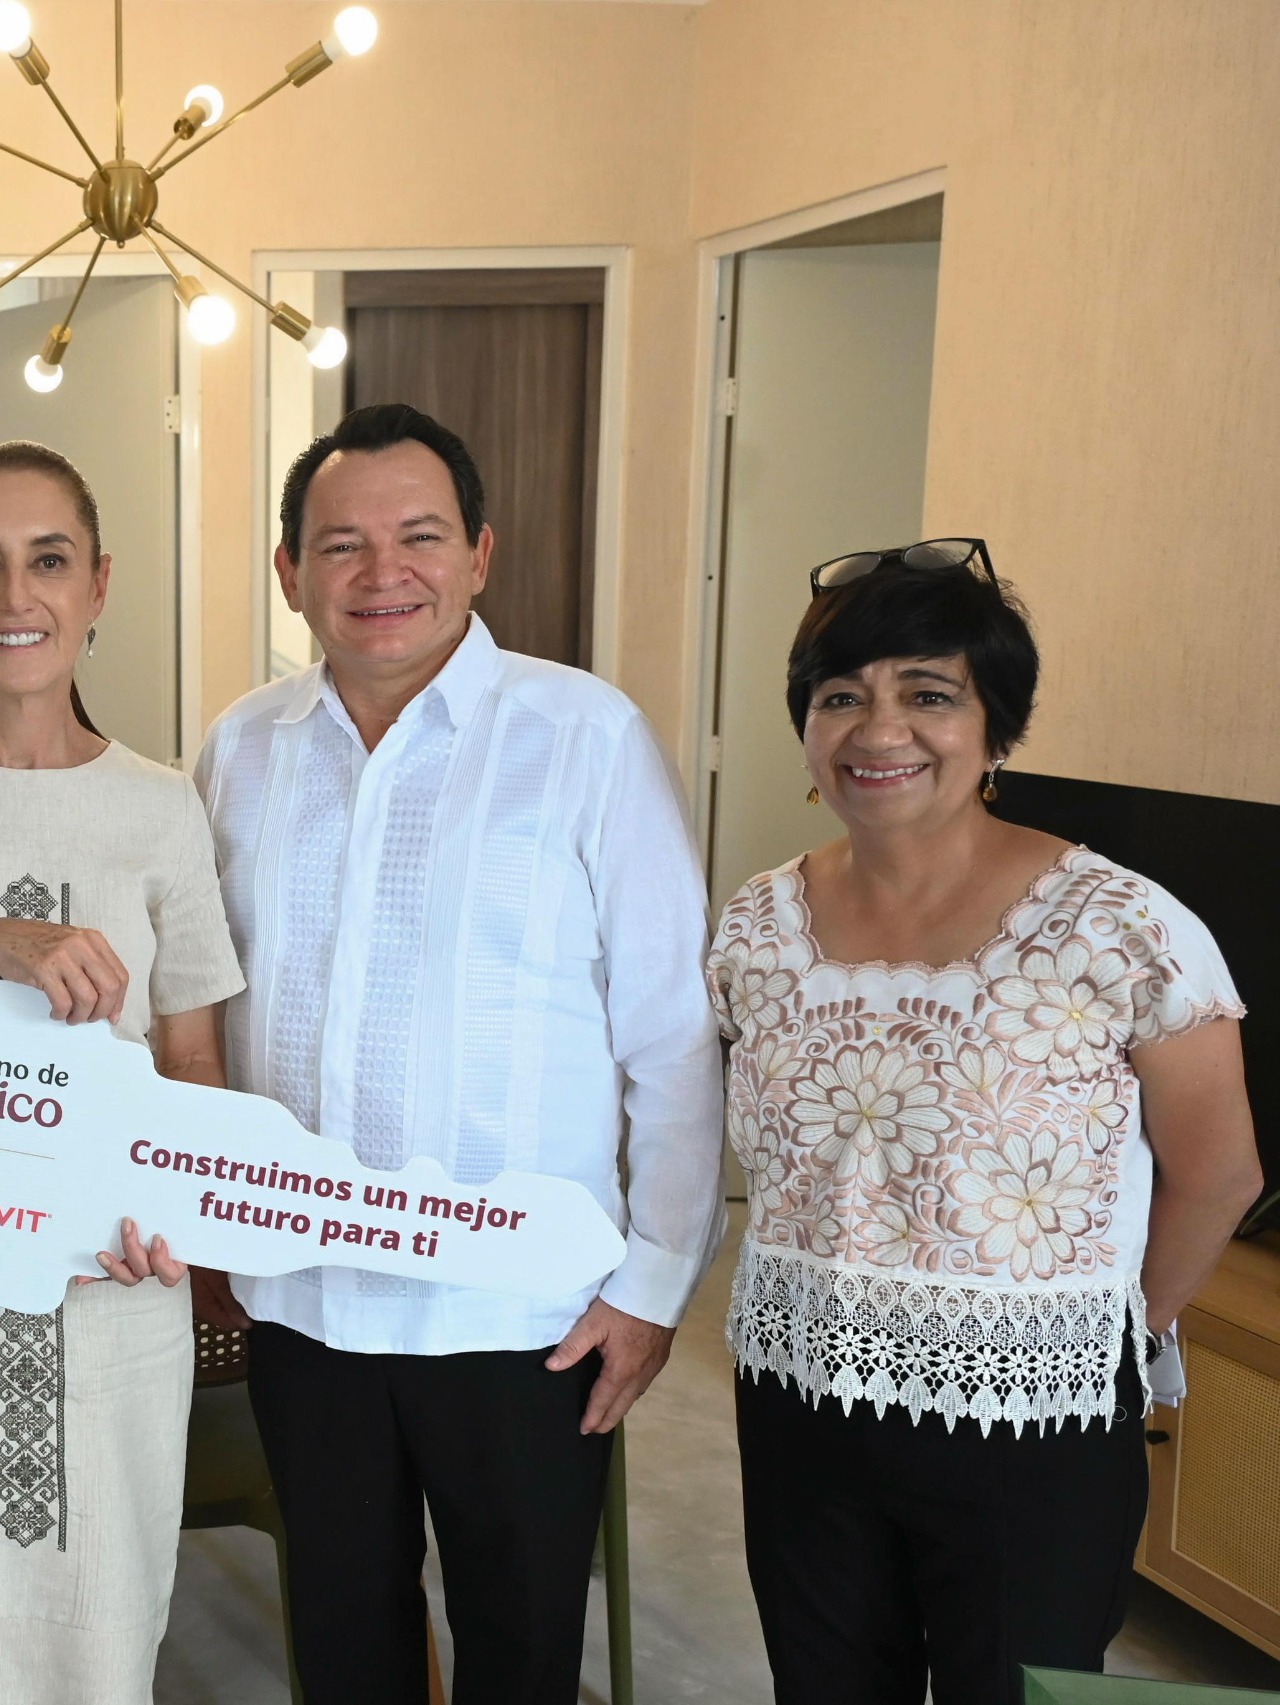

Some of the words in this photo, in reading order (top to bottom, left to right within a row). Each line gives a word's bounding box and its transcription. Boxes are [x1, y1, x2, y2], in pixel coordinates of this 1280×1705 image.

[37, 1063, 69, 1087] de
[129, 1139, 352, 1201] Construimos
[362, 1184, 408, 1211] un
[418, 1193, 527, 1232] mejor
[199, 1191, 311, 1235] futuro
[319, 1218, 401, 1252] para
[412, 1230, 439, 1258] ti
